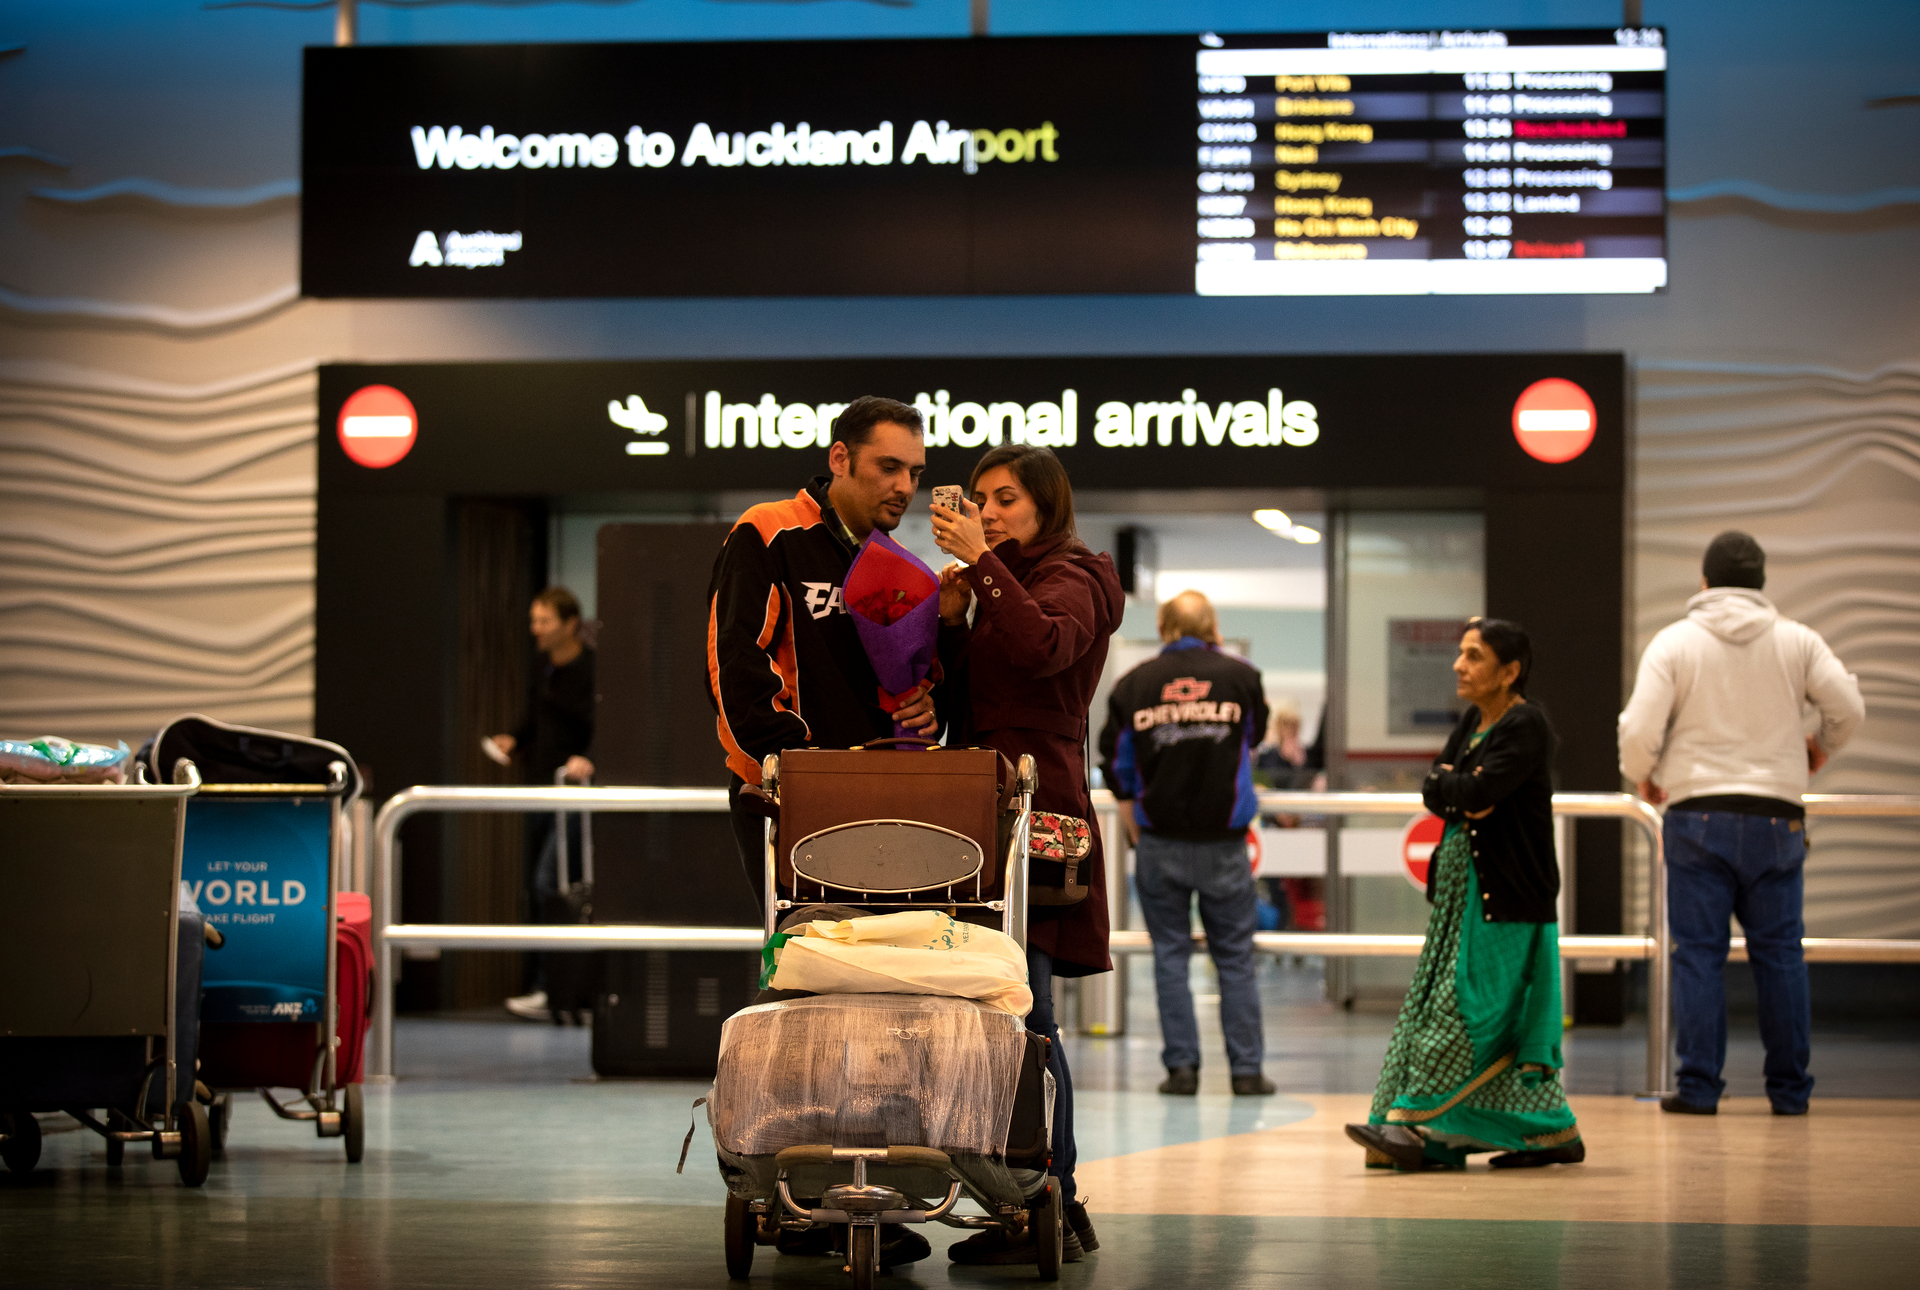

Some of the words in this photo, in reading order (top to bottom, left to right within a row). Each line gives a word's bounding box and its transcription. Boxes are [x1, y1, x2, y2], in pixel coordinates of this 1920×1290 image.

[1513, 73, 1613, 92] Processing
[1275, 96, 1355, 117] Brisbane
[1513, 94, 1613, 117] Processing
[1274, 122, 1324, 144] Hong
[1325, 121, 1374, 144] Kong
[411, 124, 619, 171] Welcome
[625, 126, 675, 169] to
[680, 121, 893, 168] Auckland
[901, 119, 1059, 175] Airport
[1513, 141, 1613, 166] Processing
[1274, 169, 1342, 193] Sydney
[1513, 167, 1613, 191] Processing
[1274, 195, 1324, 217] Hong
[1324, 194, 1373, 217] Kong
[1513, 193, 1581, 214] Landed
[1380, 216, 1420, 240] City
[704, 390, 1077, 449] Intertional
[1093, 387, 1320, 448] arrivals
[207, 861, 230, 873] LET
[234, 861, 268, 873] YOUR
[203, 912, 230, 924] AKE
[232, 912, 276, 925] FLIGHT
[272, 1001, 304, 1016] ANZ
